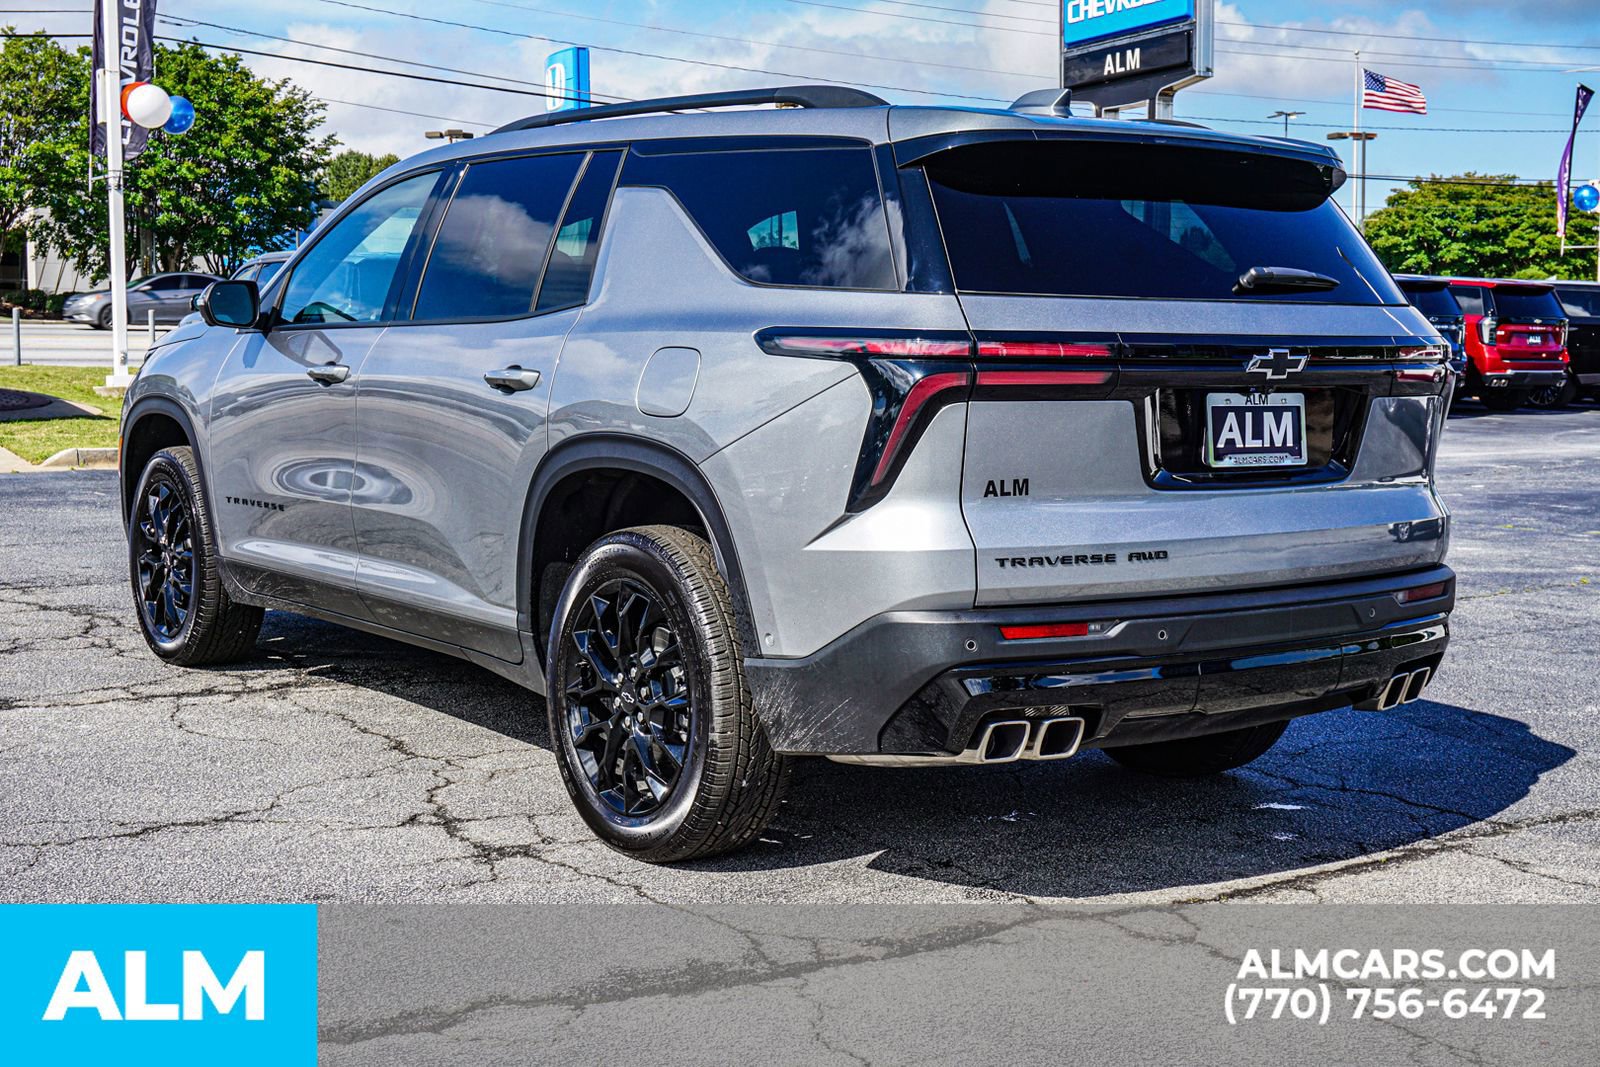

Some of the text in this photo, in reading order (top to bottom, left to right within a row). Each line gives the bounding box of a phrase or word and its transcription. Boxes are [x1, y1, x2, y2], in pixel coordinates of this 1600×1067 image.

[1103, 47, 1141, 76] ALM
[1244, 393, 1269, 405] ALM
[1216, 411, 1294, 448] ALM
[983, 478, 1029, 497] ALM
[225, 496, 285, 512] TRAVERSE
[995, 550, 1169, 568] TRAVERSE AWD
